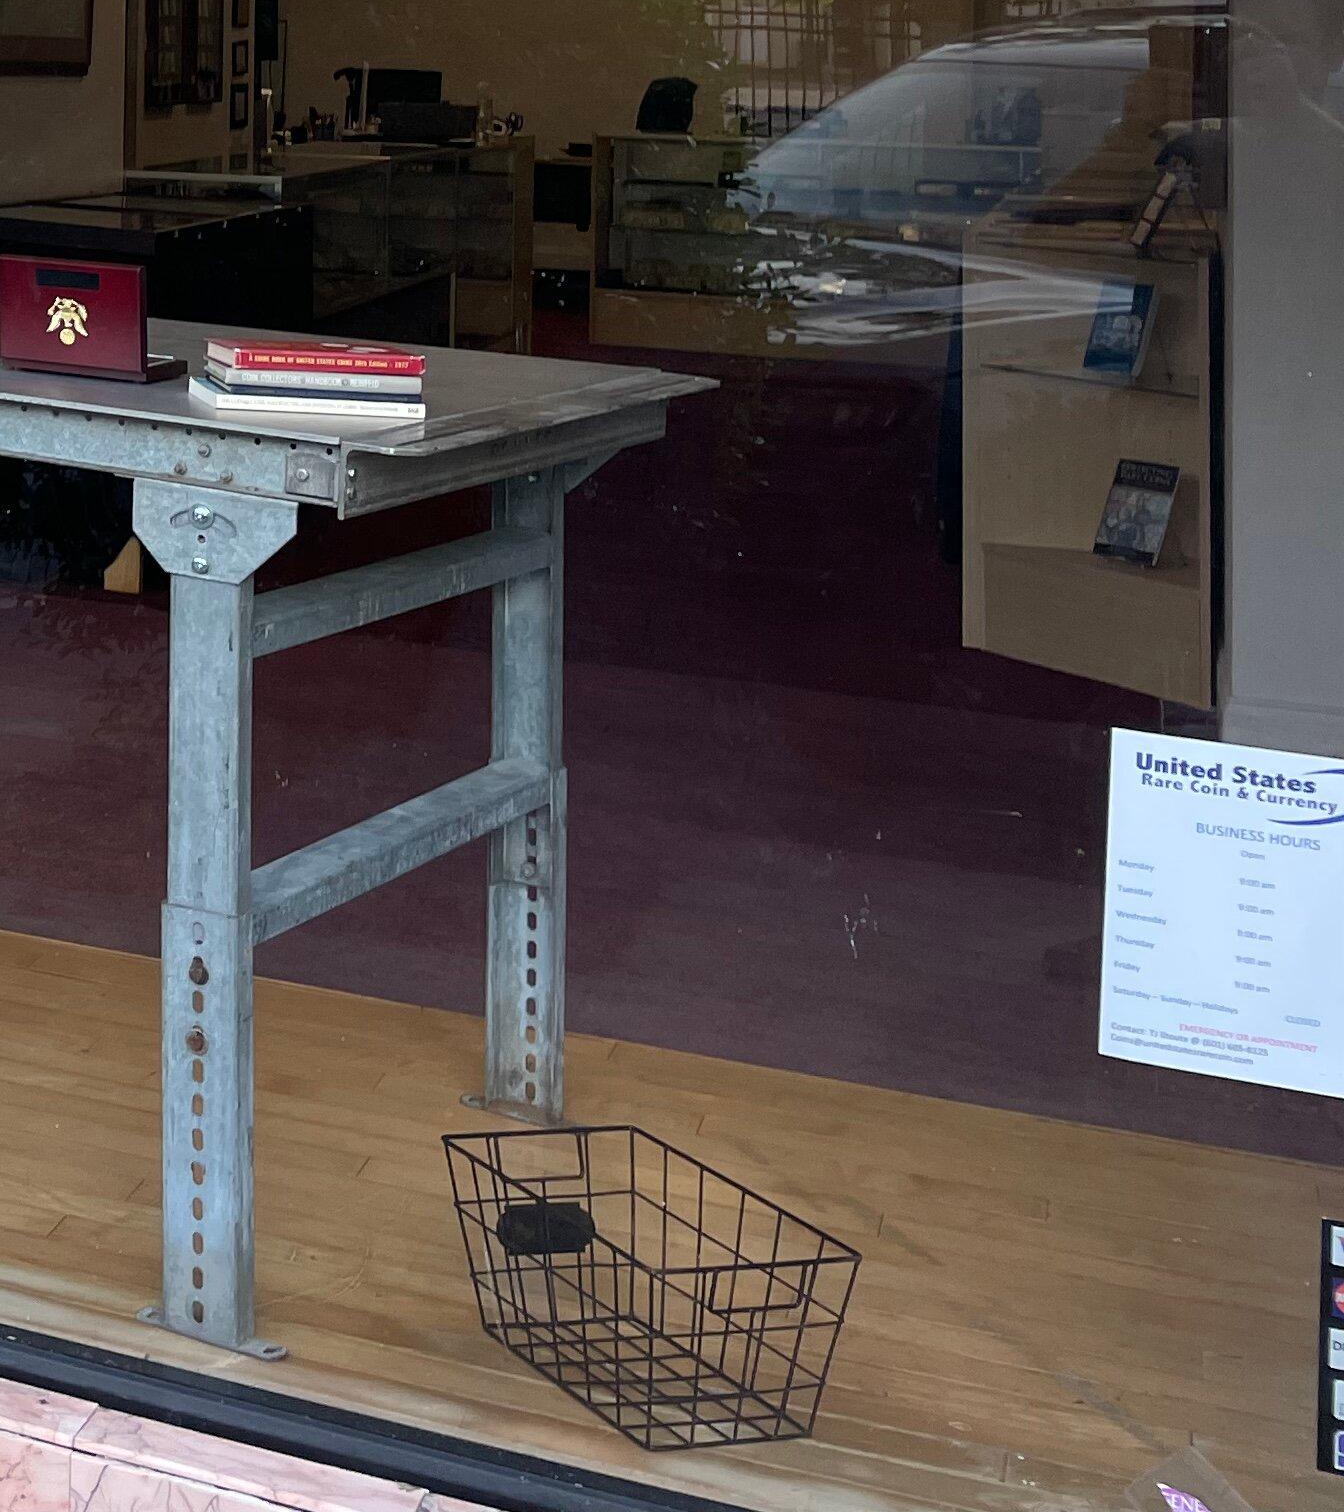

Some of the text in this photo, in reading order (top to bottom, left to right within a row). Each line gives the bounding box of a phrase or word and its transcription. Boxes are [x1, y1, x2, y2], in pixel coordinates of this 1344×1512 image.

[1136, 752, 1317, 794] United States
[1141, 773, 1338, 815] Rare Coin & Currency
[1196, 822, 1321, 850] BUSINESS HOURS
[1118, 859, 1154, 873] Monday
[1117, 884, 1153, 898] Tuesday
[1116, 910, 1167, 925] Wednesday
[1115, 935, 1155, 949] Thursday
[1113, 960, 1141, 973] Friday
